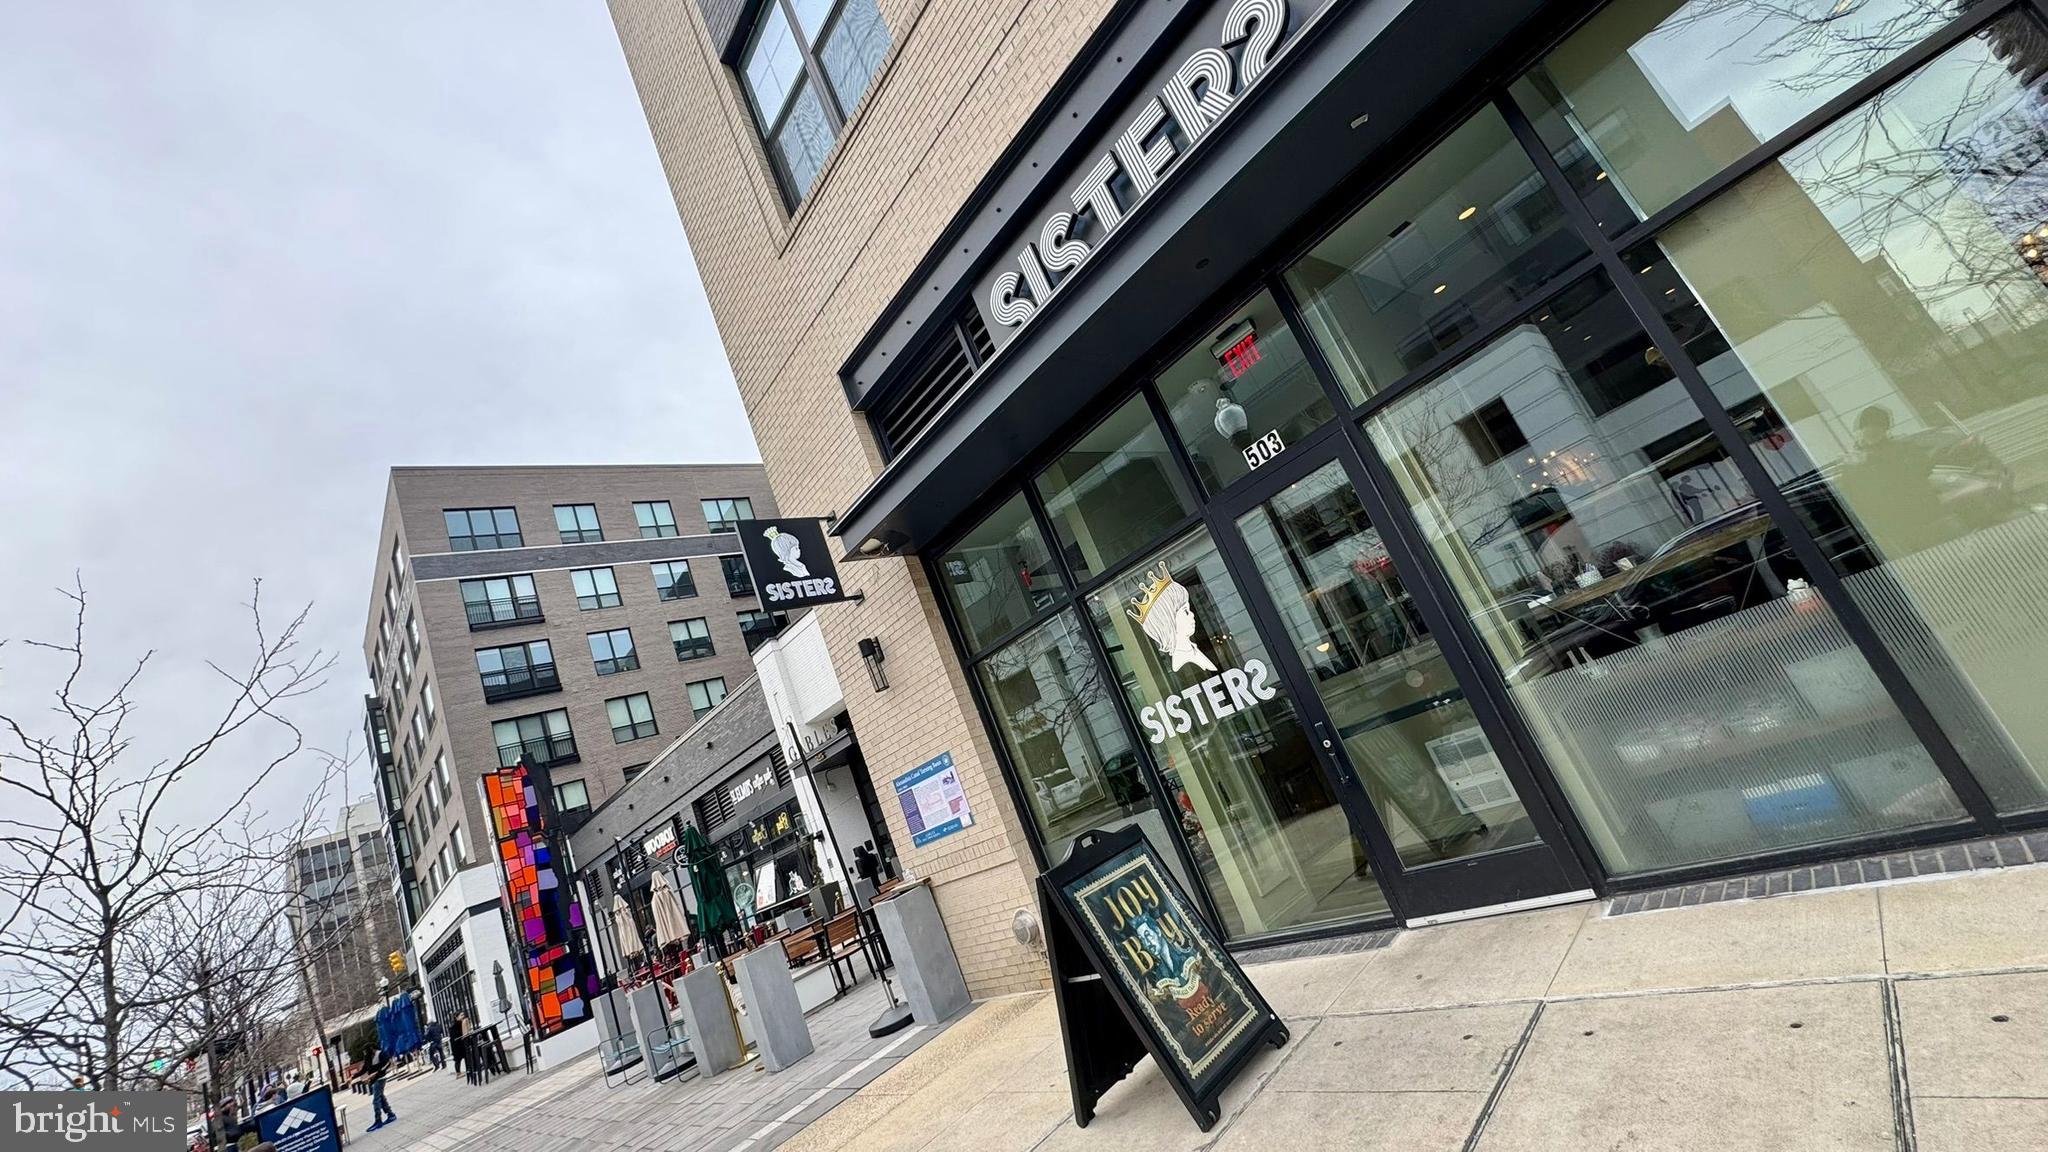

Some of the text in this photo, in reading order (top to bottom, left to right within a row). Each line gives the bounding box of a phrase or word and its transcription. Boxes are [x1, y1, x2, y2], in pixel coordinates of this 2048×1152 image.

[990, 0, 1288, 326] SISTERS
[1244, 432, 1283, 468] 503
[765, 577, 837, 602] SISTERS
[1140, 658, 1276, 744] SISTERS
[788, 717, 838, 761] GBLES
[1103, 874, 1159, 931] JOY
[1121, 912, 1185, 976] BY
[1185, 995, 1216, 1020] Ready
[1192, 1024, 1205, 1037] to
[1203, 1002, 1228, 1025] serve
